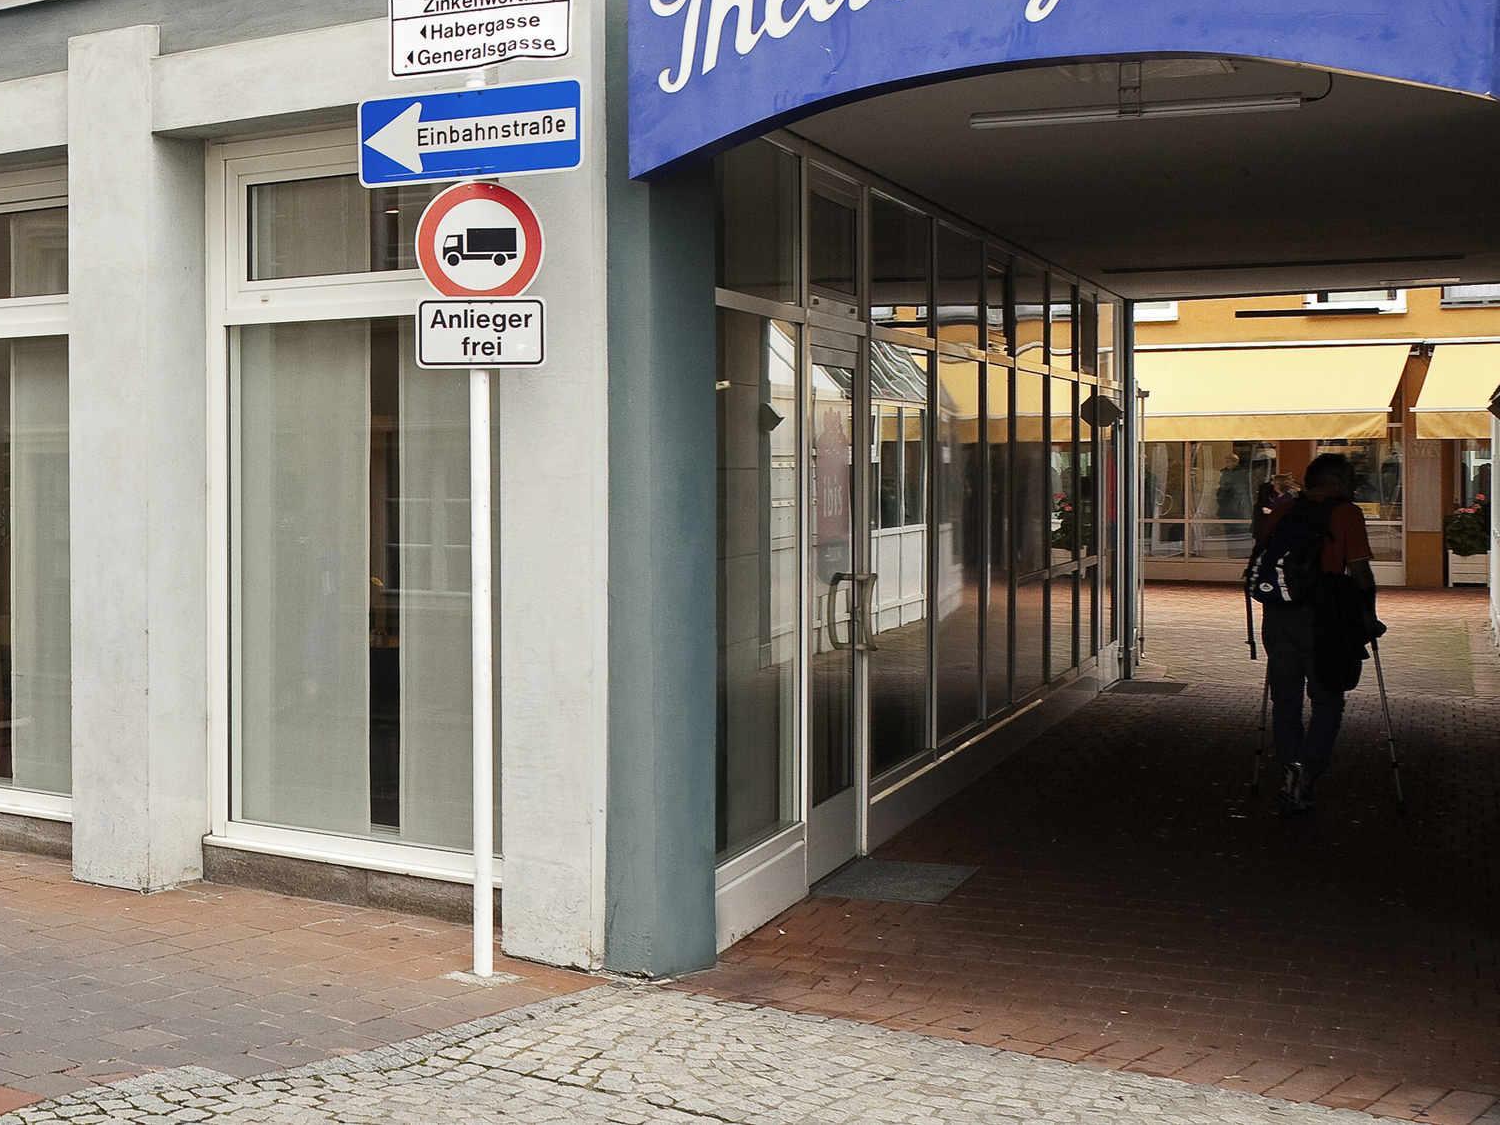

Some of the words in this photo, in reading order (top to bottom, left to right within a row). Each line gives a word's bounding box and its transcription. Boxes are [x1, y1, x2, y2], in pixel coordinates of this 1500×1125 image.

[431, 16, 540, 41] Habergasse
[417, 38, 556, 66] Generalsgasse
[417, 115, 566, 147] Einbahnstraße
[430, 308, 533, 333] Anlieger
[461, 336, 502, 356] frei
